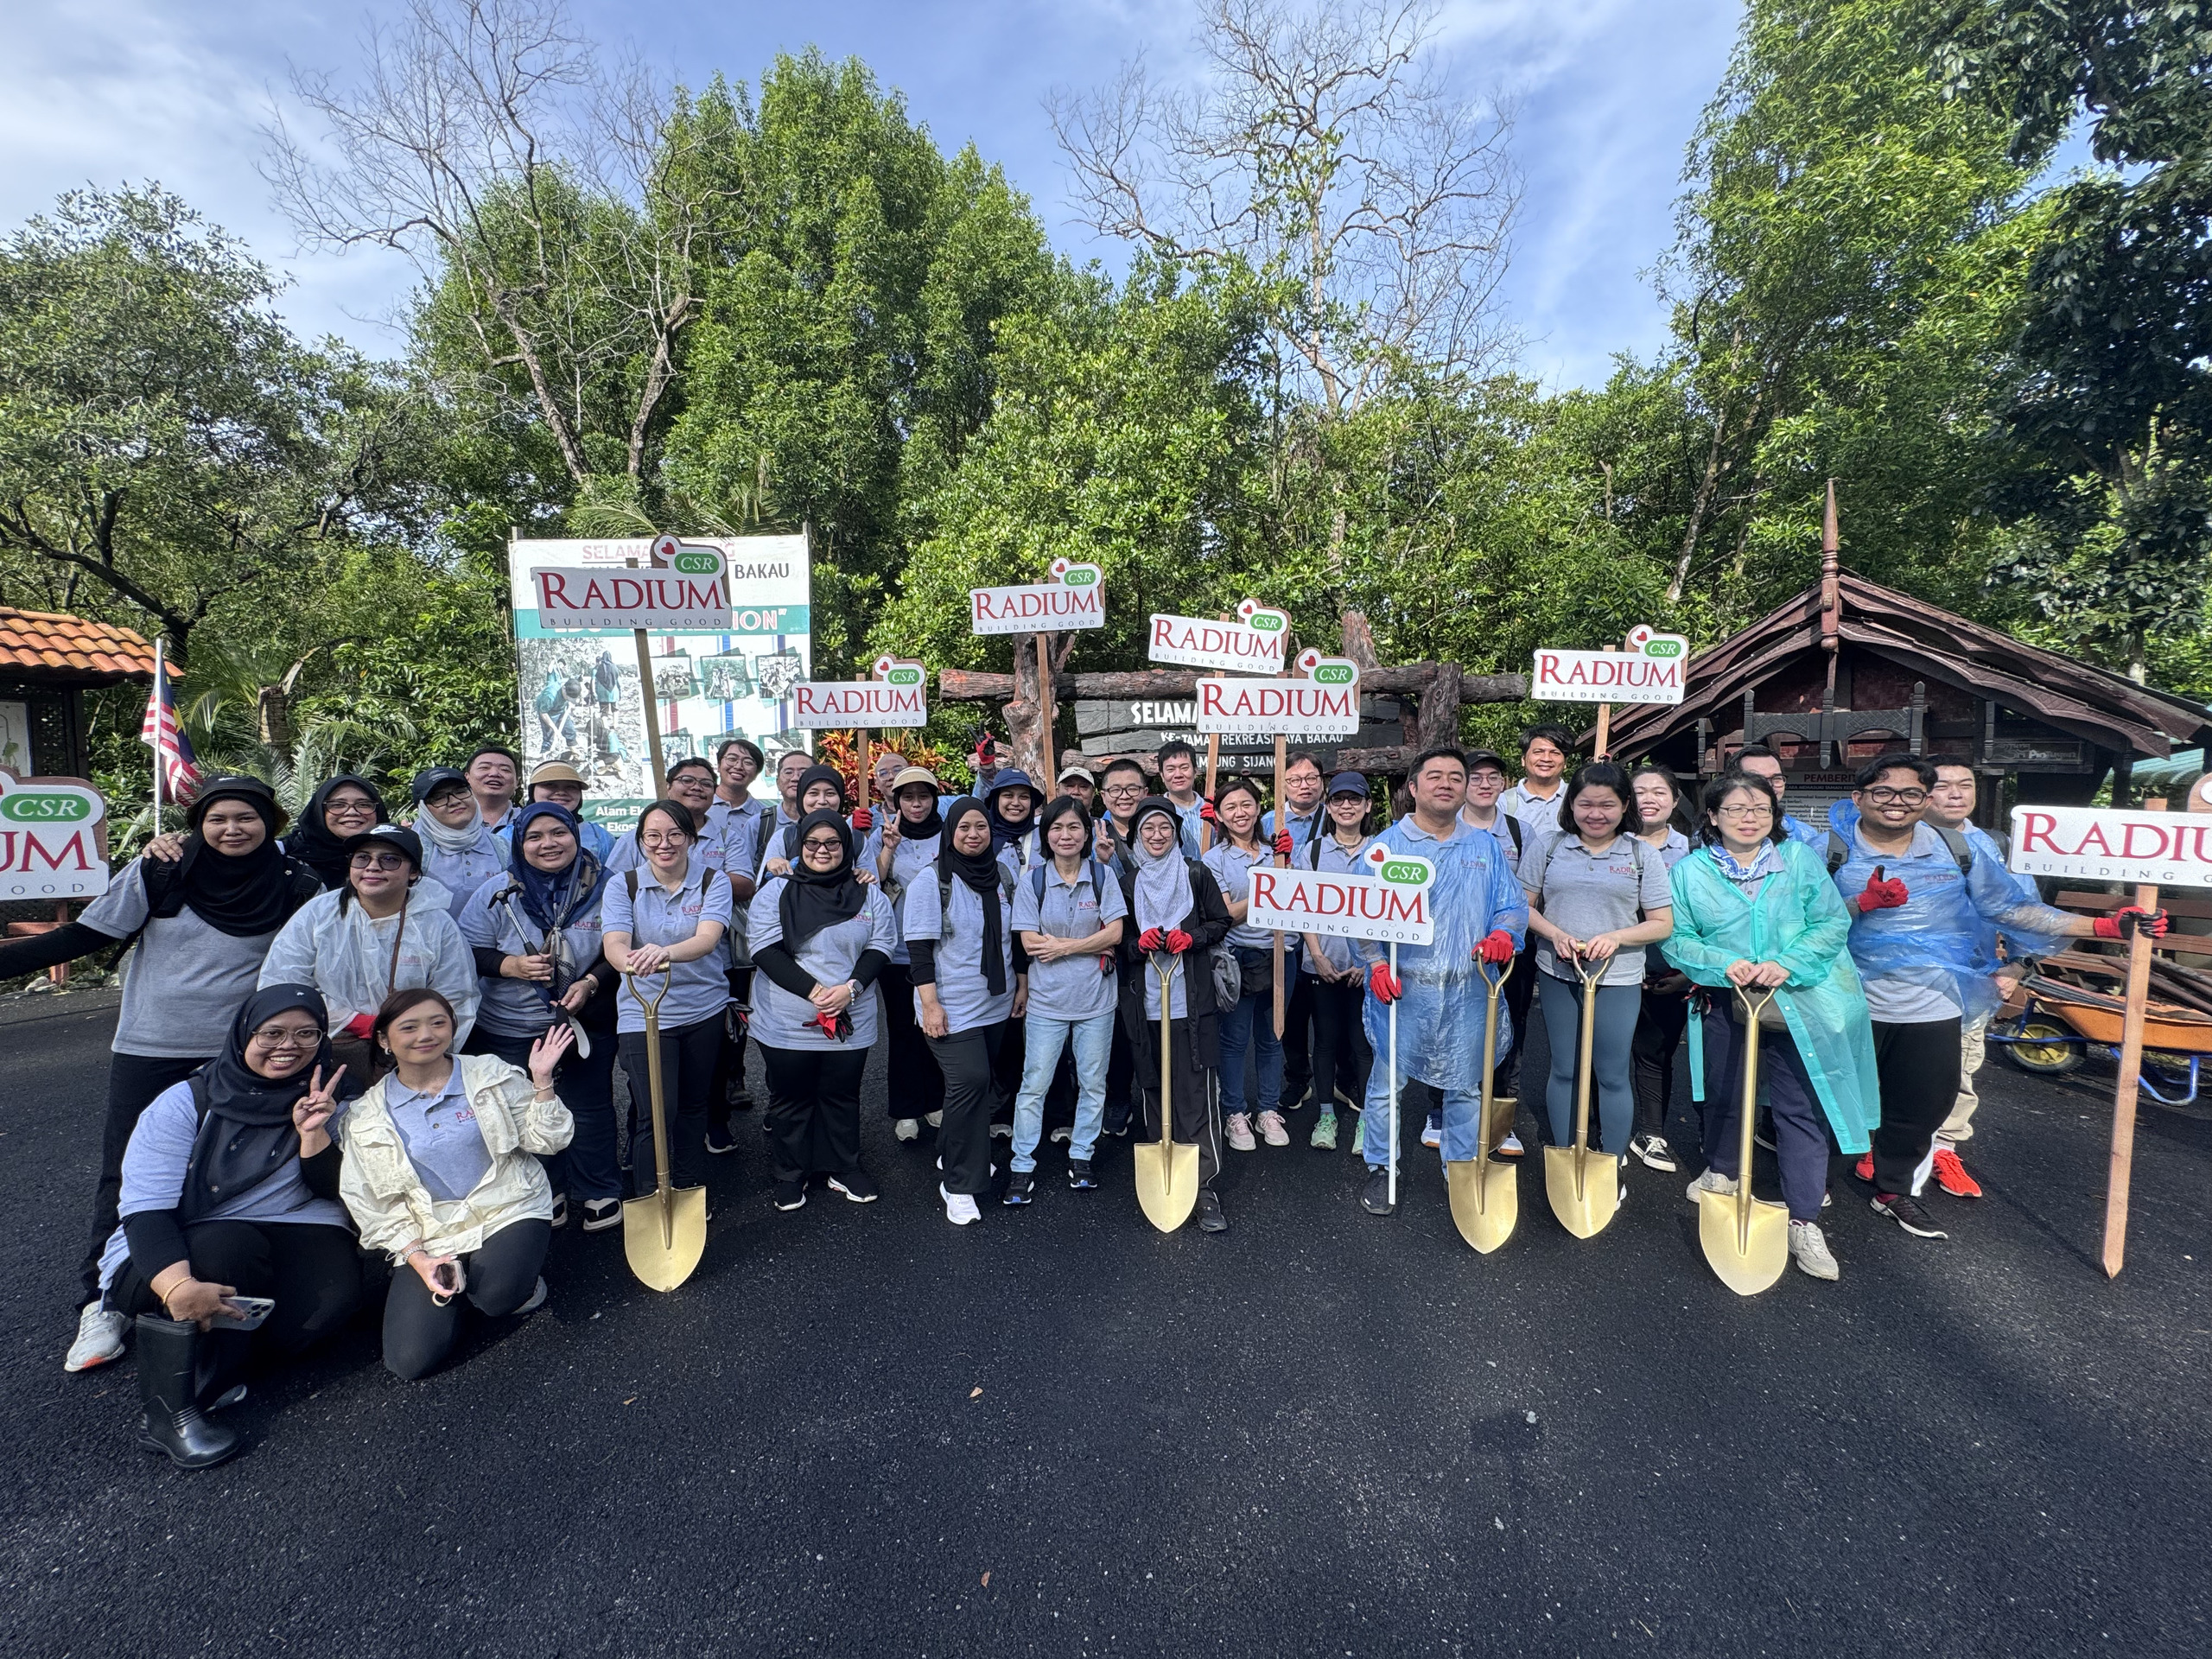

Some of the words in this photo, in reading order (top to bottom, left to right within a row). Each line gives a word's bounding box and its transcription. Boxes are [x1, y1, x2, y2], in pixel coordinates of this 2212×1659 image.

[582, 544, 649, 559] SELAMA
[680, 557, 714, 570] CSR
[734, 563, 790, 579] BAKAU
[1068, 572, 1092, 583] CSR
[537, 572, 725, 610] RADIUM
[974, 589, 1098, 620] RADIUM
[550, 618, 652, 626] BUILDING
[980, 623, 1046, 632] BUILDING
[1254, 617, 1279, 629] CSR
[1154, 619, 1280, 659] RADIUM
[1649, 643, 1676, 655] CSR
[1155, 653, 1225, 666] BUILDING
[1237, 663, 1274, 671] GOOD
[892, 671, 916, 682] CSR
[1319, 669, 1348, 681] CSR
[1540, 654, 1678, 688] RADIUM
[795, 687, 921, 714] RADIUM
[1201, 683, 1353, 717] RADIUM
[1130, 701, 1198, 725] SELAM
[1160, 732, 1210, 747] KE-TAMA
[1221, 734, 1274, 746] REKREASI
[1285, 734, 1303, 744] AYA
[1306, 734, 1344, 744] BAKAU
[1243, 755, 1276, 767] SIJAN
[1803, 773, 1856, 783] PEMBERIT
[13, 799, 79, 817] CSR
[596, 805, 627, 817] Alam
[629, 805, 645, 817] Ek
[607, 822, 639, 832] Ekos
[1387, 865, 1421, 880] CSR
[2024, 862, 2175, 880] BUILDING
[11, 883, 84, 895] OOD
[1253, 873, 1427, 925] RADIUM
[1255, 917, 1349, 933] BUILDING
[1366, 928, 1420, 941] GOOD
